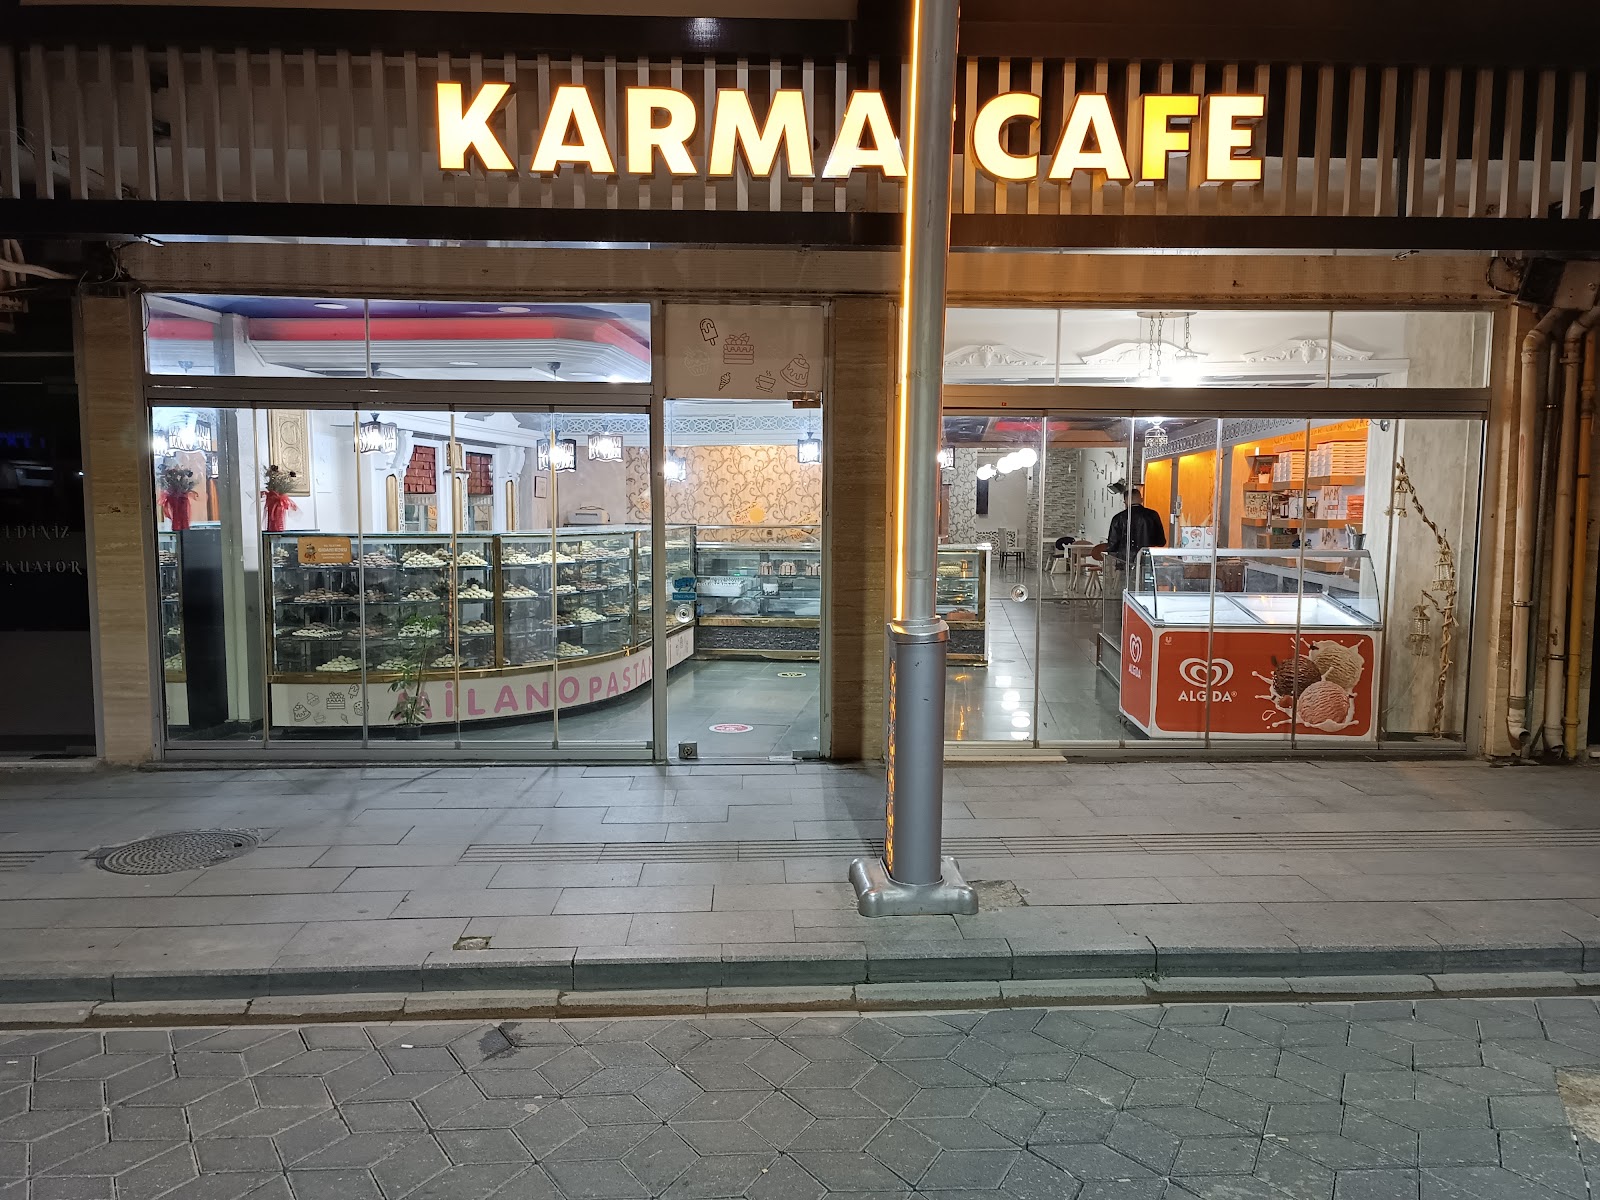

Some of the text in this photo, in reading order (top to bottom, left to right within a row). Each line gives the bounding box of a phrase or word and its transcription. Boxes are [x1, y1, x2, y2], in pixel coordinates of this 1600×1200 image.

[436, 82, 1266, 182] KARMA CAFE
[1178, 690, 1233, 703] ALGDA
